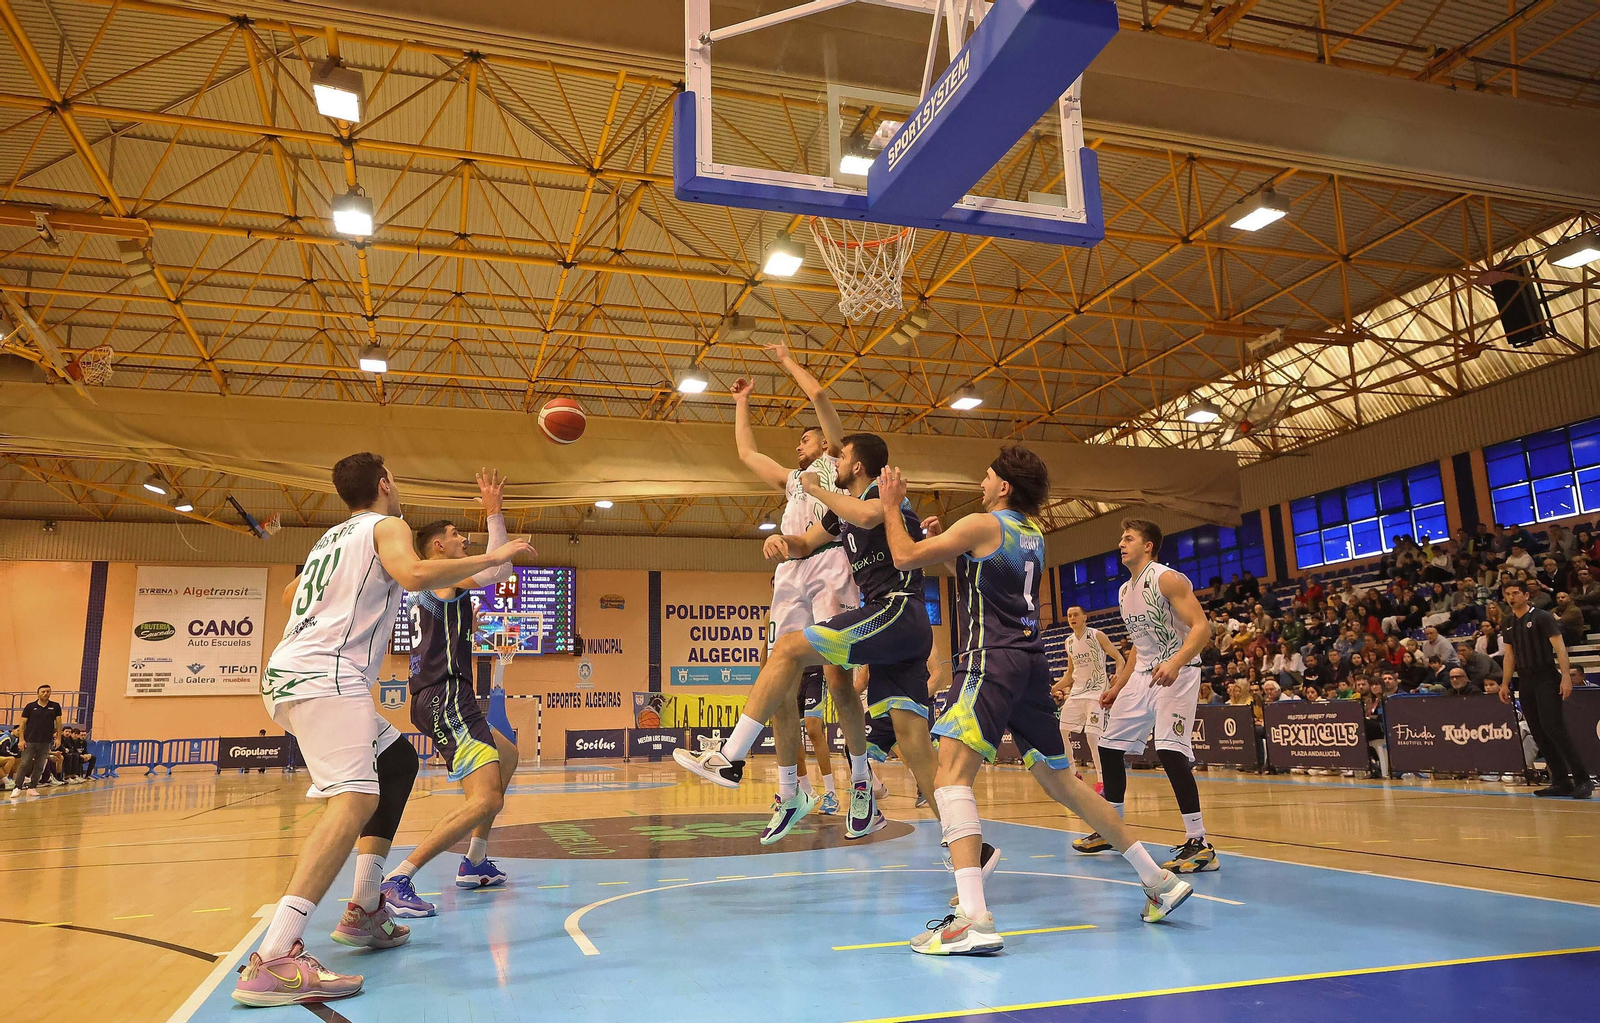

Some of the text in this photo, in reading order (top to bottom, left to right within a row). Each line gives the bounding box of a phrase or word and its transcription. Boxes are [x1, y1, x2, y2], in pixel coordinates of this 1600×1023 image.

[888, 48, 970, 166] SPORT SYSTEM
[847, 532, 857, 553] 0
[296, 547, 341, 616] 34
[499, 582, 516, 594] 24
[1024, 561, 1035, 611] 1
[183, 587, 249, 597] Algetransit
[493, 597, 513, 610] 31
[665, 604, 770, 620] POLIDEPORT
[188, 617, 253, 636] CANÓ
[410, 604, 422, 649] 3
[690, 626, 766, 641] CIUDAD D
[188, 639, 252, 647] Auto Escuelas
[587, 638, 623, 654] MUNICIPAL
[688, 647, 763, 663] ALGECIR
[186, 676, 216, 684] Galera
[546, 691, 621, 708] DEPORTES ALGECIRAS
[429, 695, 448, 745] damex.io
[698, 697, 742, 728] FORTA
[1392, 722, 1513, 745] Frida KubeClub
[234, 747, 279, 758] populares
[575, 738, 616, 751] Socibus
